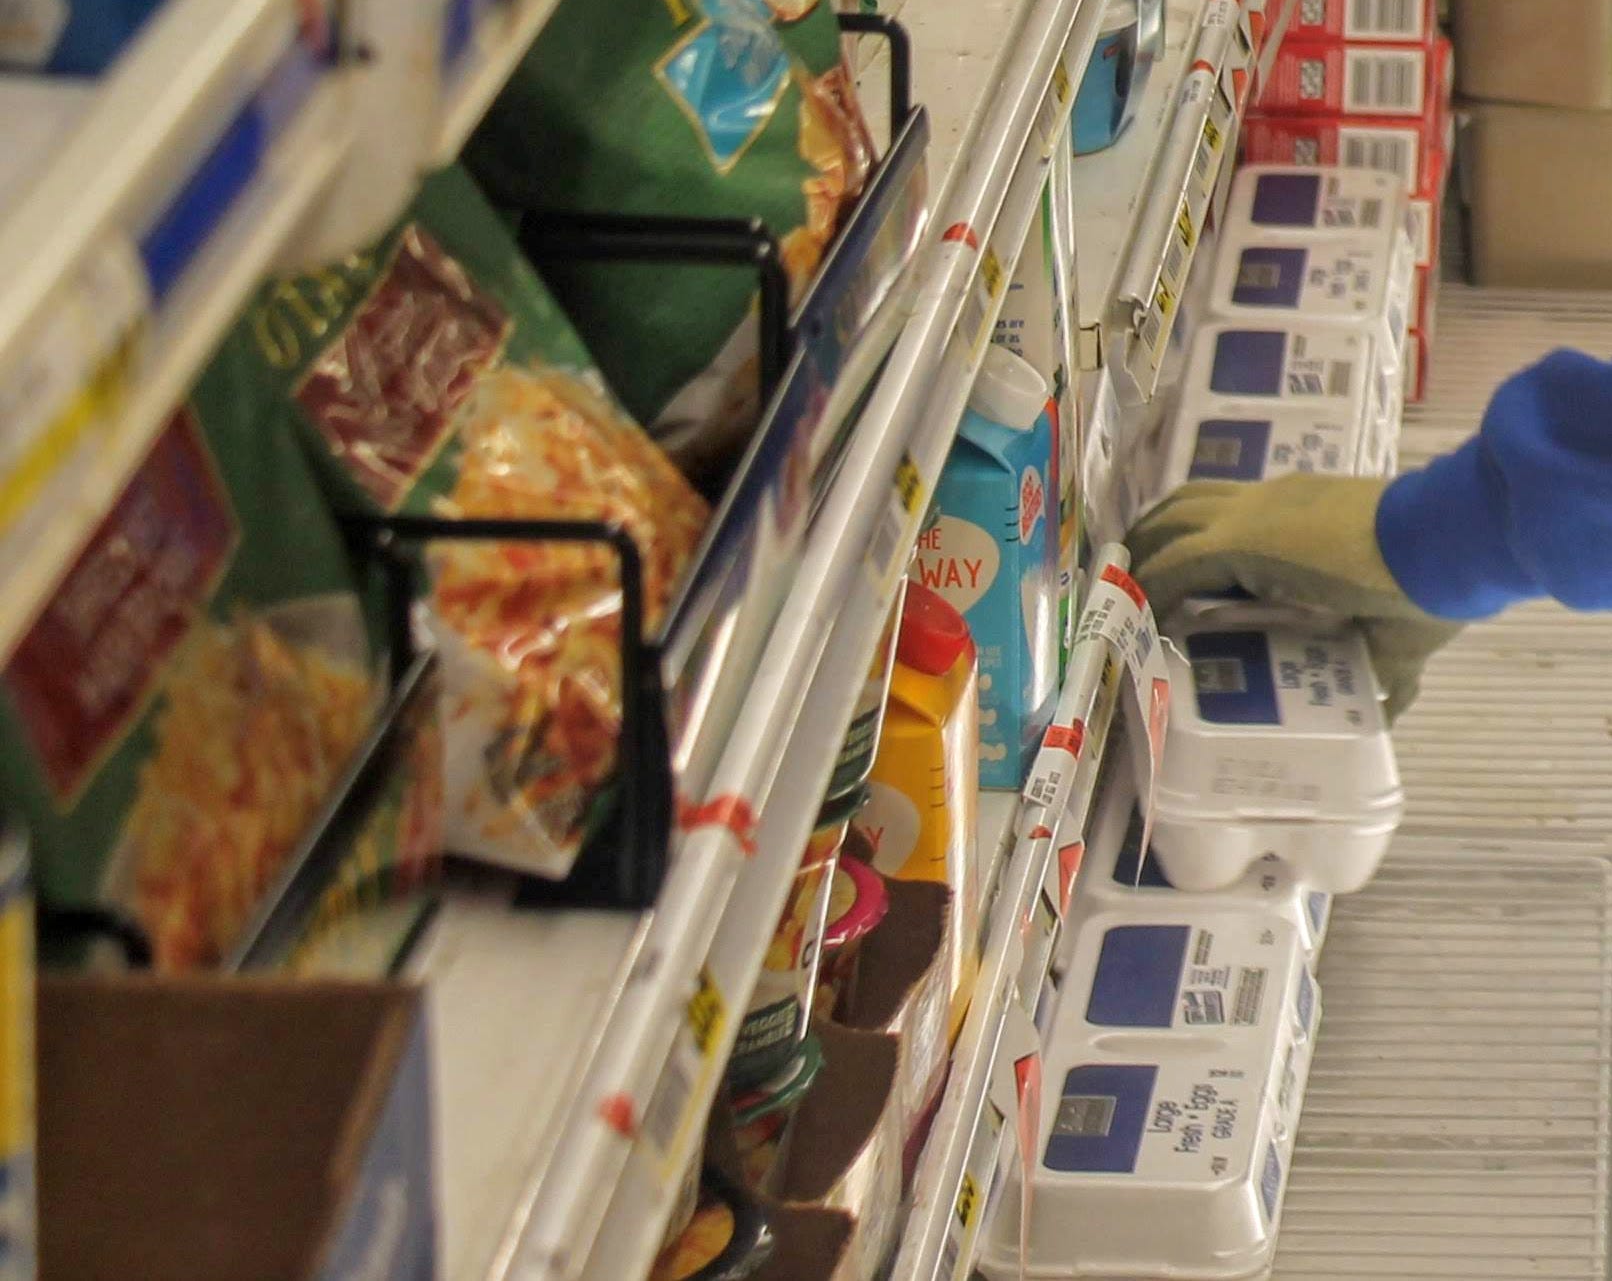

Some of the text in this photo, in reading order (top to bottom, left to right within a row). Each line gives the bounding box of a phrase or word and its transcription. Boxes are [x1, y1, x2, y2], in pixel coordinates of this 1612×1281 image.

[918, 557, 982, 589] WAY
[1146, 1100, 1182, 1134] Large
[1174, 1083, 1218, 1154] Fresh Eggs
